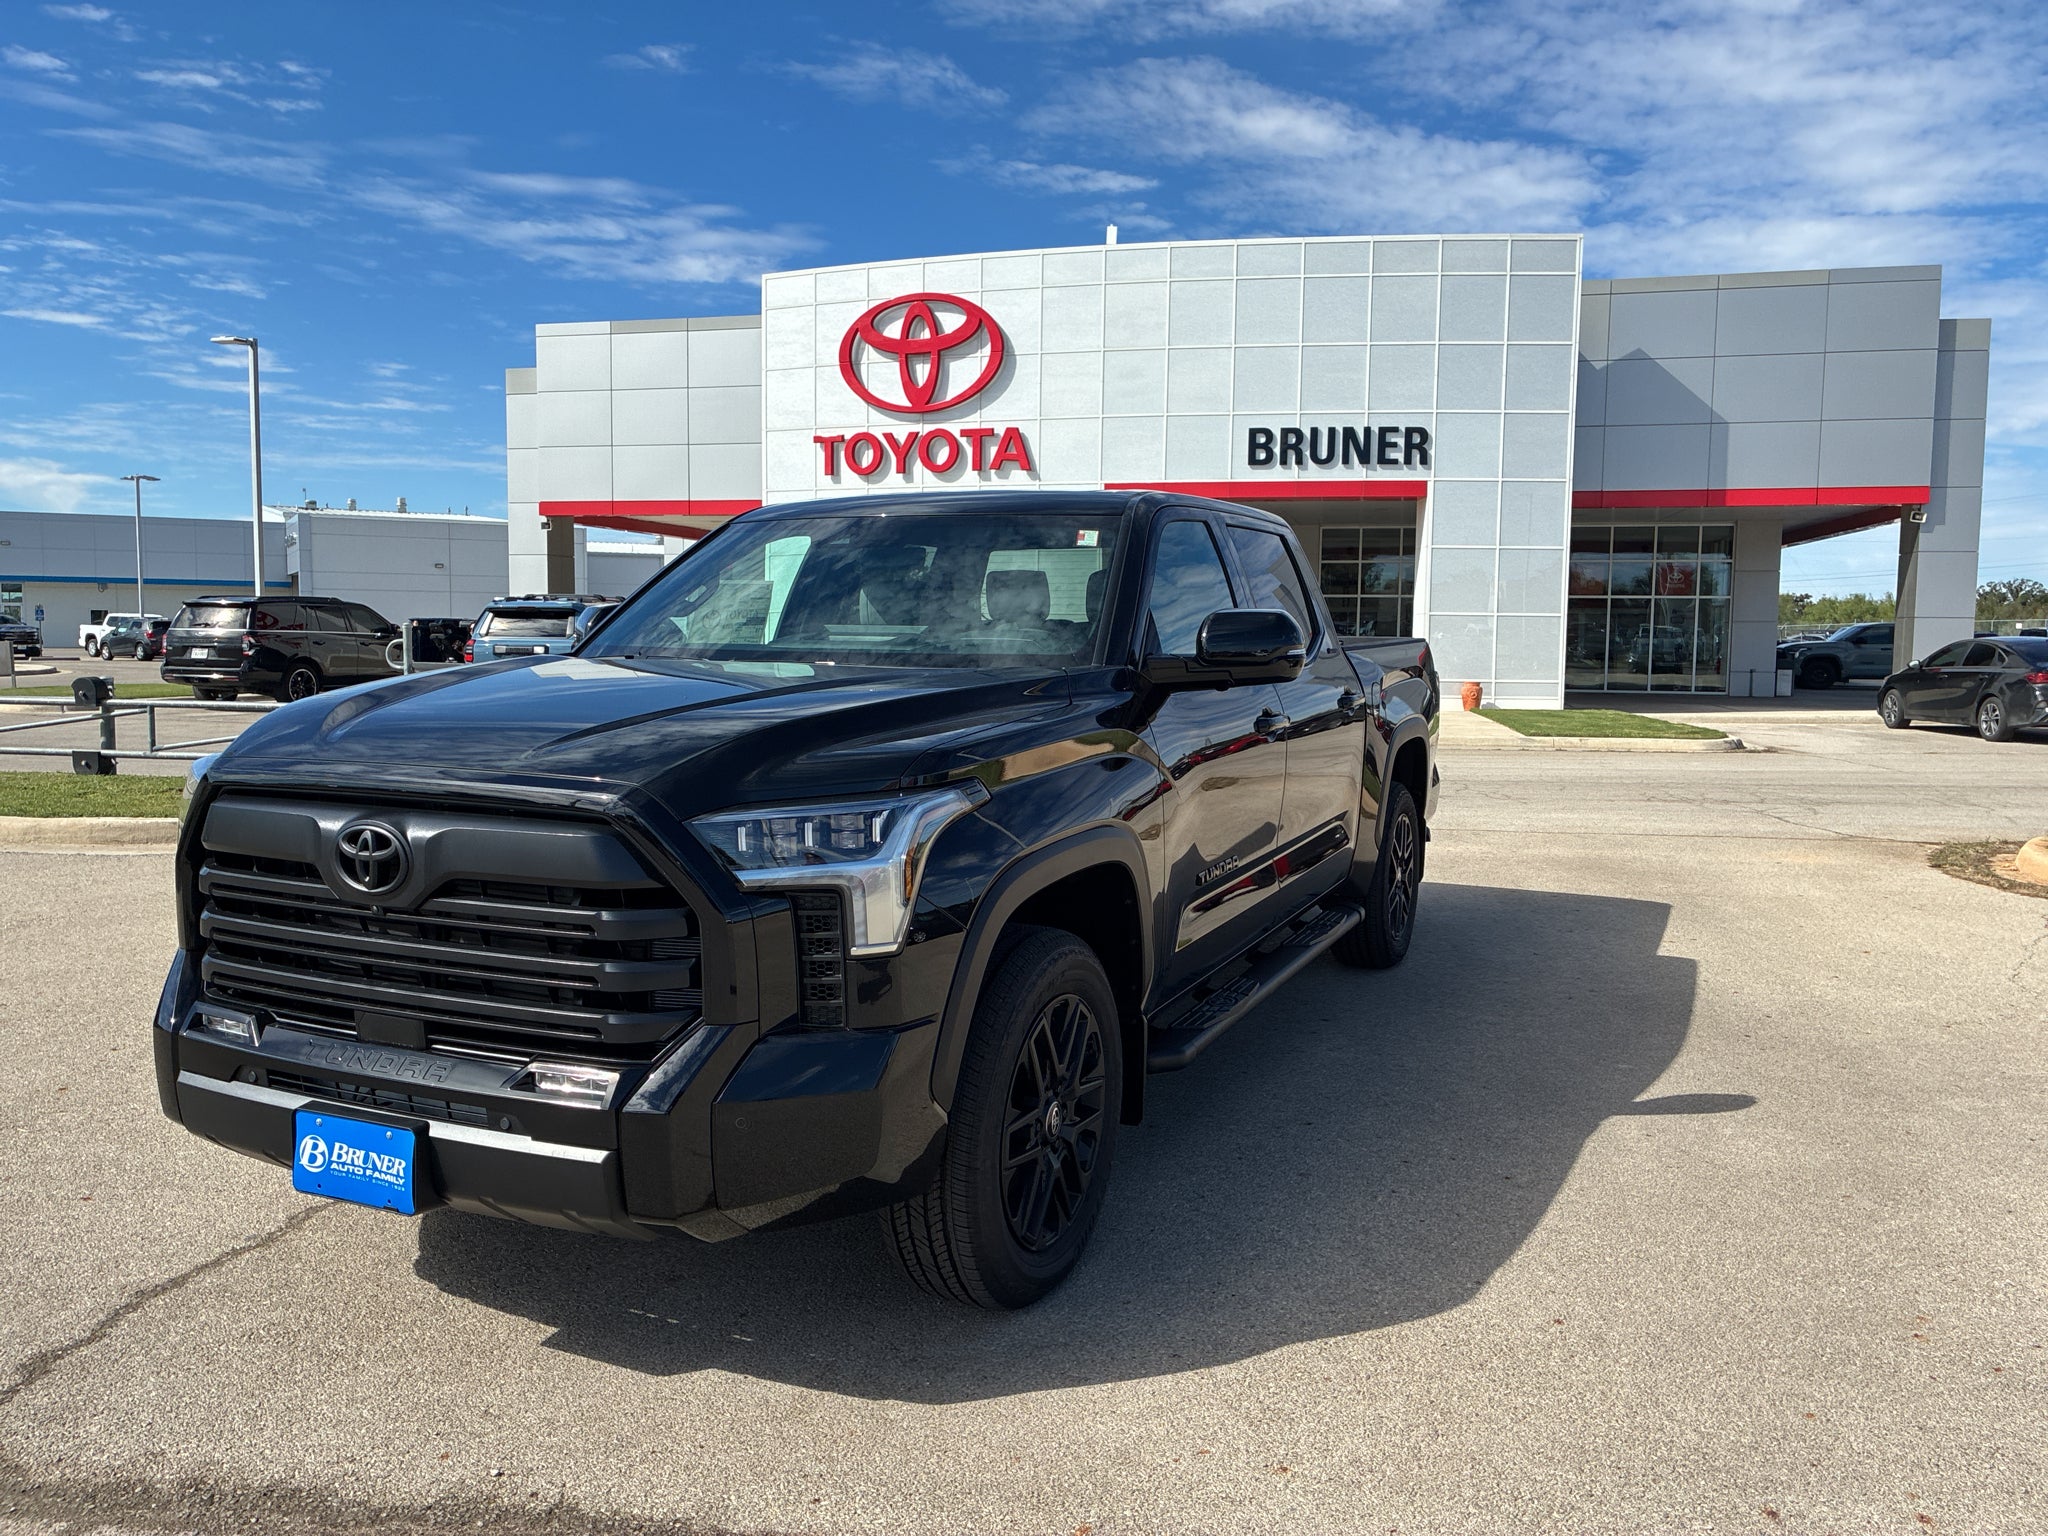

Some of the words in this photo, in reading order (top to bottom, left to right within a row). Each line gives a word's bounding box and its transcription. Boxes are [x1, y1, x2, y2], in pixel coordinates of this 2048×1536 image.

[813, 427, 1031, 476] TOYOTA
[1247, 426, 1429, 466] BRUNER
[1197, 855, 1240, 886] TUNDRA
[305, 1039, 454, 1083] TUNDRA
[330, 1162, 364, 1175] AUTO
[365, 1169, 406, 1185] FAMILY
[331, 1142, 407, 1177] BRUNER
[348, 1174, 369, 1182] FAMILY
